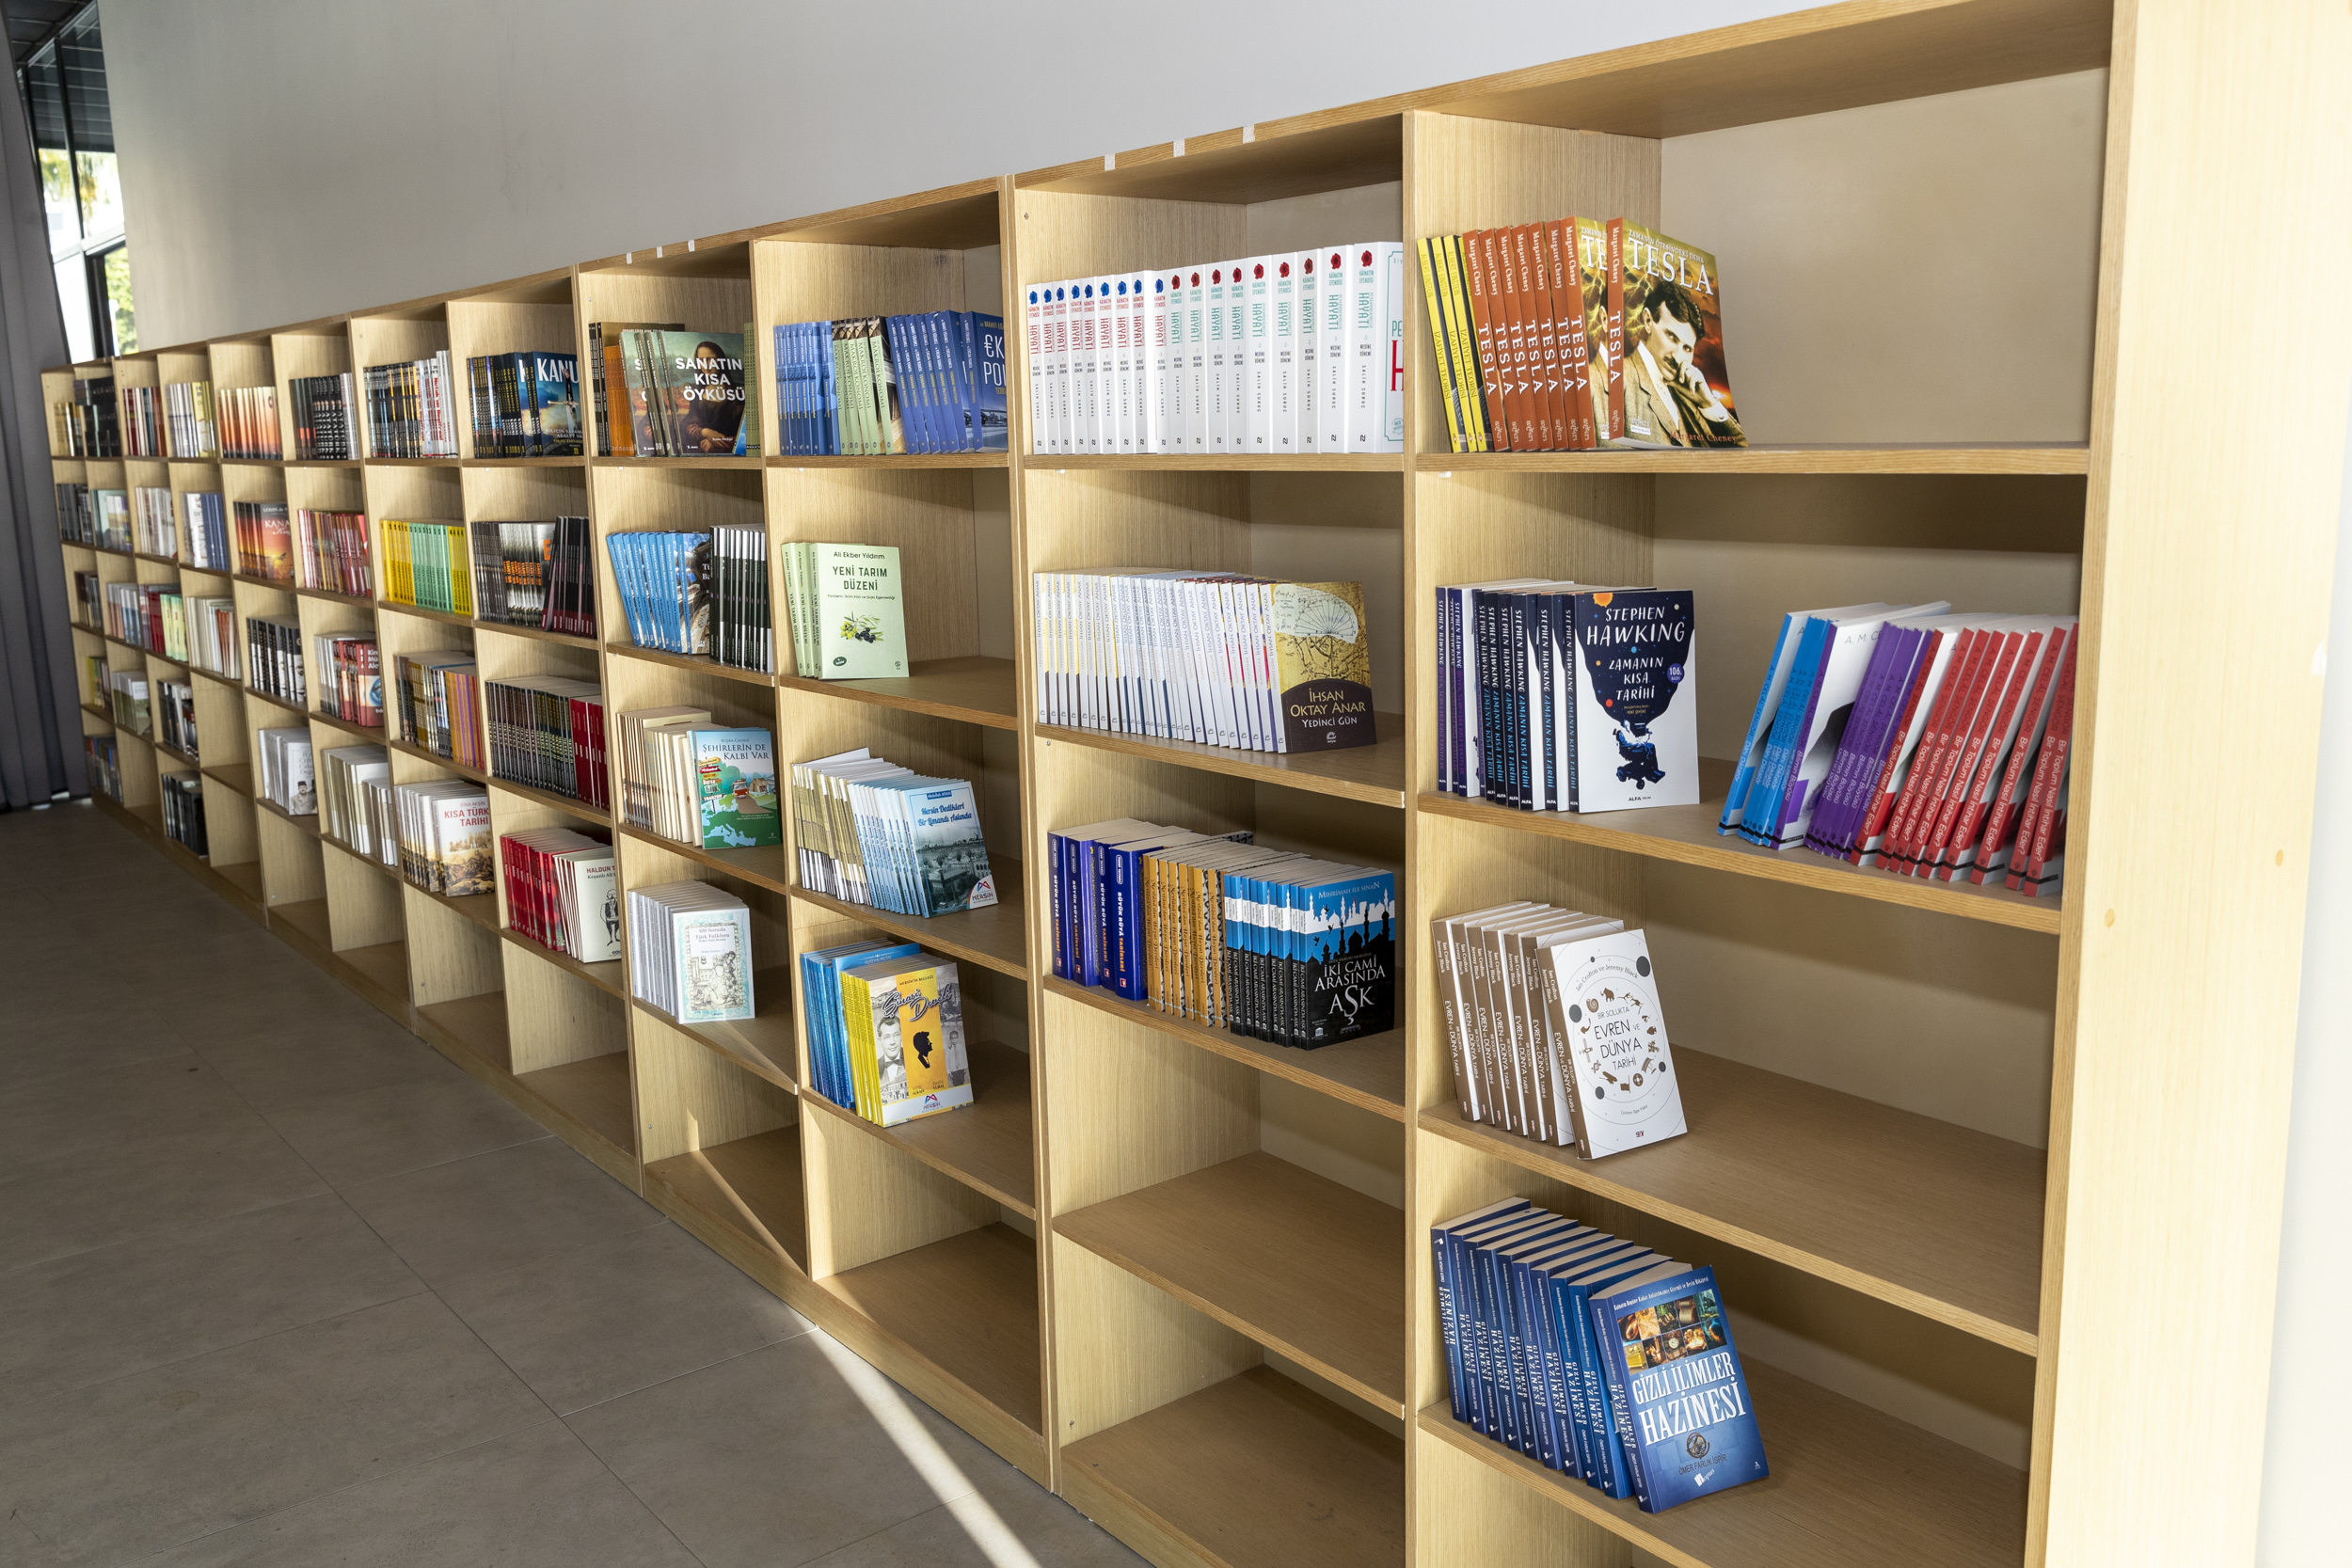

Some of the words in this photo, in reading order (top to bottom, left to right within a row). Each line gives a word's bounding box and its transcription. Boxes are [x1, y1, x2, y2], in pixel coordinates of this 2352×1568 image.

[1533, 231, 1541, 263] Margaret
[1629, 229, 1654, 245] ZAMANIN
[1469, 239, 1478, 271] Margaret
[1485, 238, 1494, 269] Margaret
[1536, 263, 1544, 291] Cheney
[1568, 259, 1576, 286] Cheney
[1628, 237, 1713, 295] TESLA
[1472, 271, 1482, 296] Cheney
[1489, 270, 1498, 295] Cheney
[1117, 317, 1127, 347] HAYATI
[1134, 315, 1143, 347] HAYATI
[1232, 306, 1240, 340] HAYATI
[1252, 303, 1262, 337] HAYATI
[675, 358, 743, 370] SANATIN
[1496, 323, 1514, 395] TESLA
[1510, 321, 1528, 394] TESLA
[1526, 320, 1543, 393] TESLA
[1541, 318, 1558, 393] TESLA
[1558, 317, 1575, 392] TESLA
[537, 358, 579, 383] KANU
[694, 373, 731, 385] KISA
[683, 386, 745, 401] ÖYKÜSÜ
[832, 565, 855, 576] YENİ
[860, 567, 888, 577] TARIM
[843, 579, 878, 590] DÜZENİ
[1606, 607, 1665, 621] STEPHEN
[1587, 622, 1685, 646] HAWKING
[1609, 657, 1664, 671] ZAMANIN
[1669, 667, 1682, 675] 106.
[1624, 672, 1648, 684] KISA
[1309, 688, 1344, 702] İHSAN
[1616, 686, 1654, 701] TARİHİ
[1290, 704, 1327, 717] OKTAY
[1332, 702, 1366, 713] ANAR
[1302, 716, 1335, 728] YEDİNCİ
[1338, 712, 1357, 725] GÜN
[1503, 649, 1511, 689] HAWKING
[1509, 756, 1517, 784] TARİHİ
[1517, 651, 1525, 692] HAWKING
[1521, 759, 1530, 788] TARİHİ
[703, 743, 752, 753] ŞEHİRLERİN
[2020, 736, 2028, 749] Bir
[2046, 736, 2055, 748] Bir
[1980, 752, 1995, 780] Toplum
[2008, 751, 2023, 780] Toplum
[2037, 751, 2052, 780] Toplum
[1971, 780, 1985, 804] Nasıl
[2001, 780, 2013, 801] Nasıl
[2032, 781, 2043, 803] Nasıl
[444, 810, 465, 819] KISA
[467, 807, 489, 816] TÜRK
[921, 807, 938, 815] Mersin
[939, 802, 965, 813] Dedikleri
[927, 815, 949, 827] Limandı
[950, 812, 972, 822] Aslında
[1954, 826, 1967, 848] Eder?
[1986, 827, 1998, 851] Eder?
[2017, 830, 2030, 855] Eder?
[1324, 962, 1340, 977] İKİ
[1345, 955, 1376, 973] CAMİ
[1581, 968, 1598, 983] Crofton
[1605, 965, 1624, 973] Jeremy
[1625, 967, 1638, 979] Black
[1314, 965, 1386, 992] ARASINDA
[882, 989, 921, 1019] Şinasi
[908, 984, 952, 1022] Develi
[1328, 985, 1375, 1025] AŞK
[1606, 1007, 1630, 1017] SOLUKTA
[1594, 1019, 1630, 1040] EVREN
[1533, 1019, 1541, 1044] EVREN
[1537, 1051, 1545, 1078] DÜNYA
[1600, 1037, 1642, 1058] DÜNYA
[1443, 1287, 1456, 1345] HAZİNESİ
[1572, 1362, 1581, 1385] GİZLİ
[1591, 1371, 1599, 1394] GİZLİ
[1632, 1367, 1671, 1405] GİZLİ
[1671, 1351, 1736, 1394] İLİMLER
[1565, 1362, 1582, 1423] HAZİNESİ
[1584, 1371, 1600, 1433] HAZİNESİ
[1618, 1384, 1628, 1408] GİZLİ
[1610, 1385, 1631, 1447] HAZİNESİ
[1639, 1377, 1746, 1447] HAZİNESİ
[1679, 1464, 1694, 1475] ÖMER
[1694, 1459, 1712, 1469] FARUK
[1713, 1454, 1727, 1464] İSPİR
